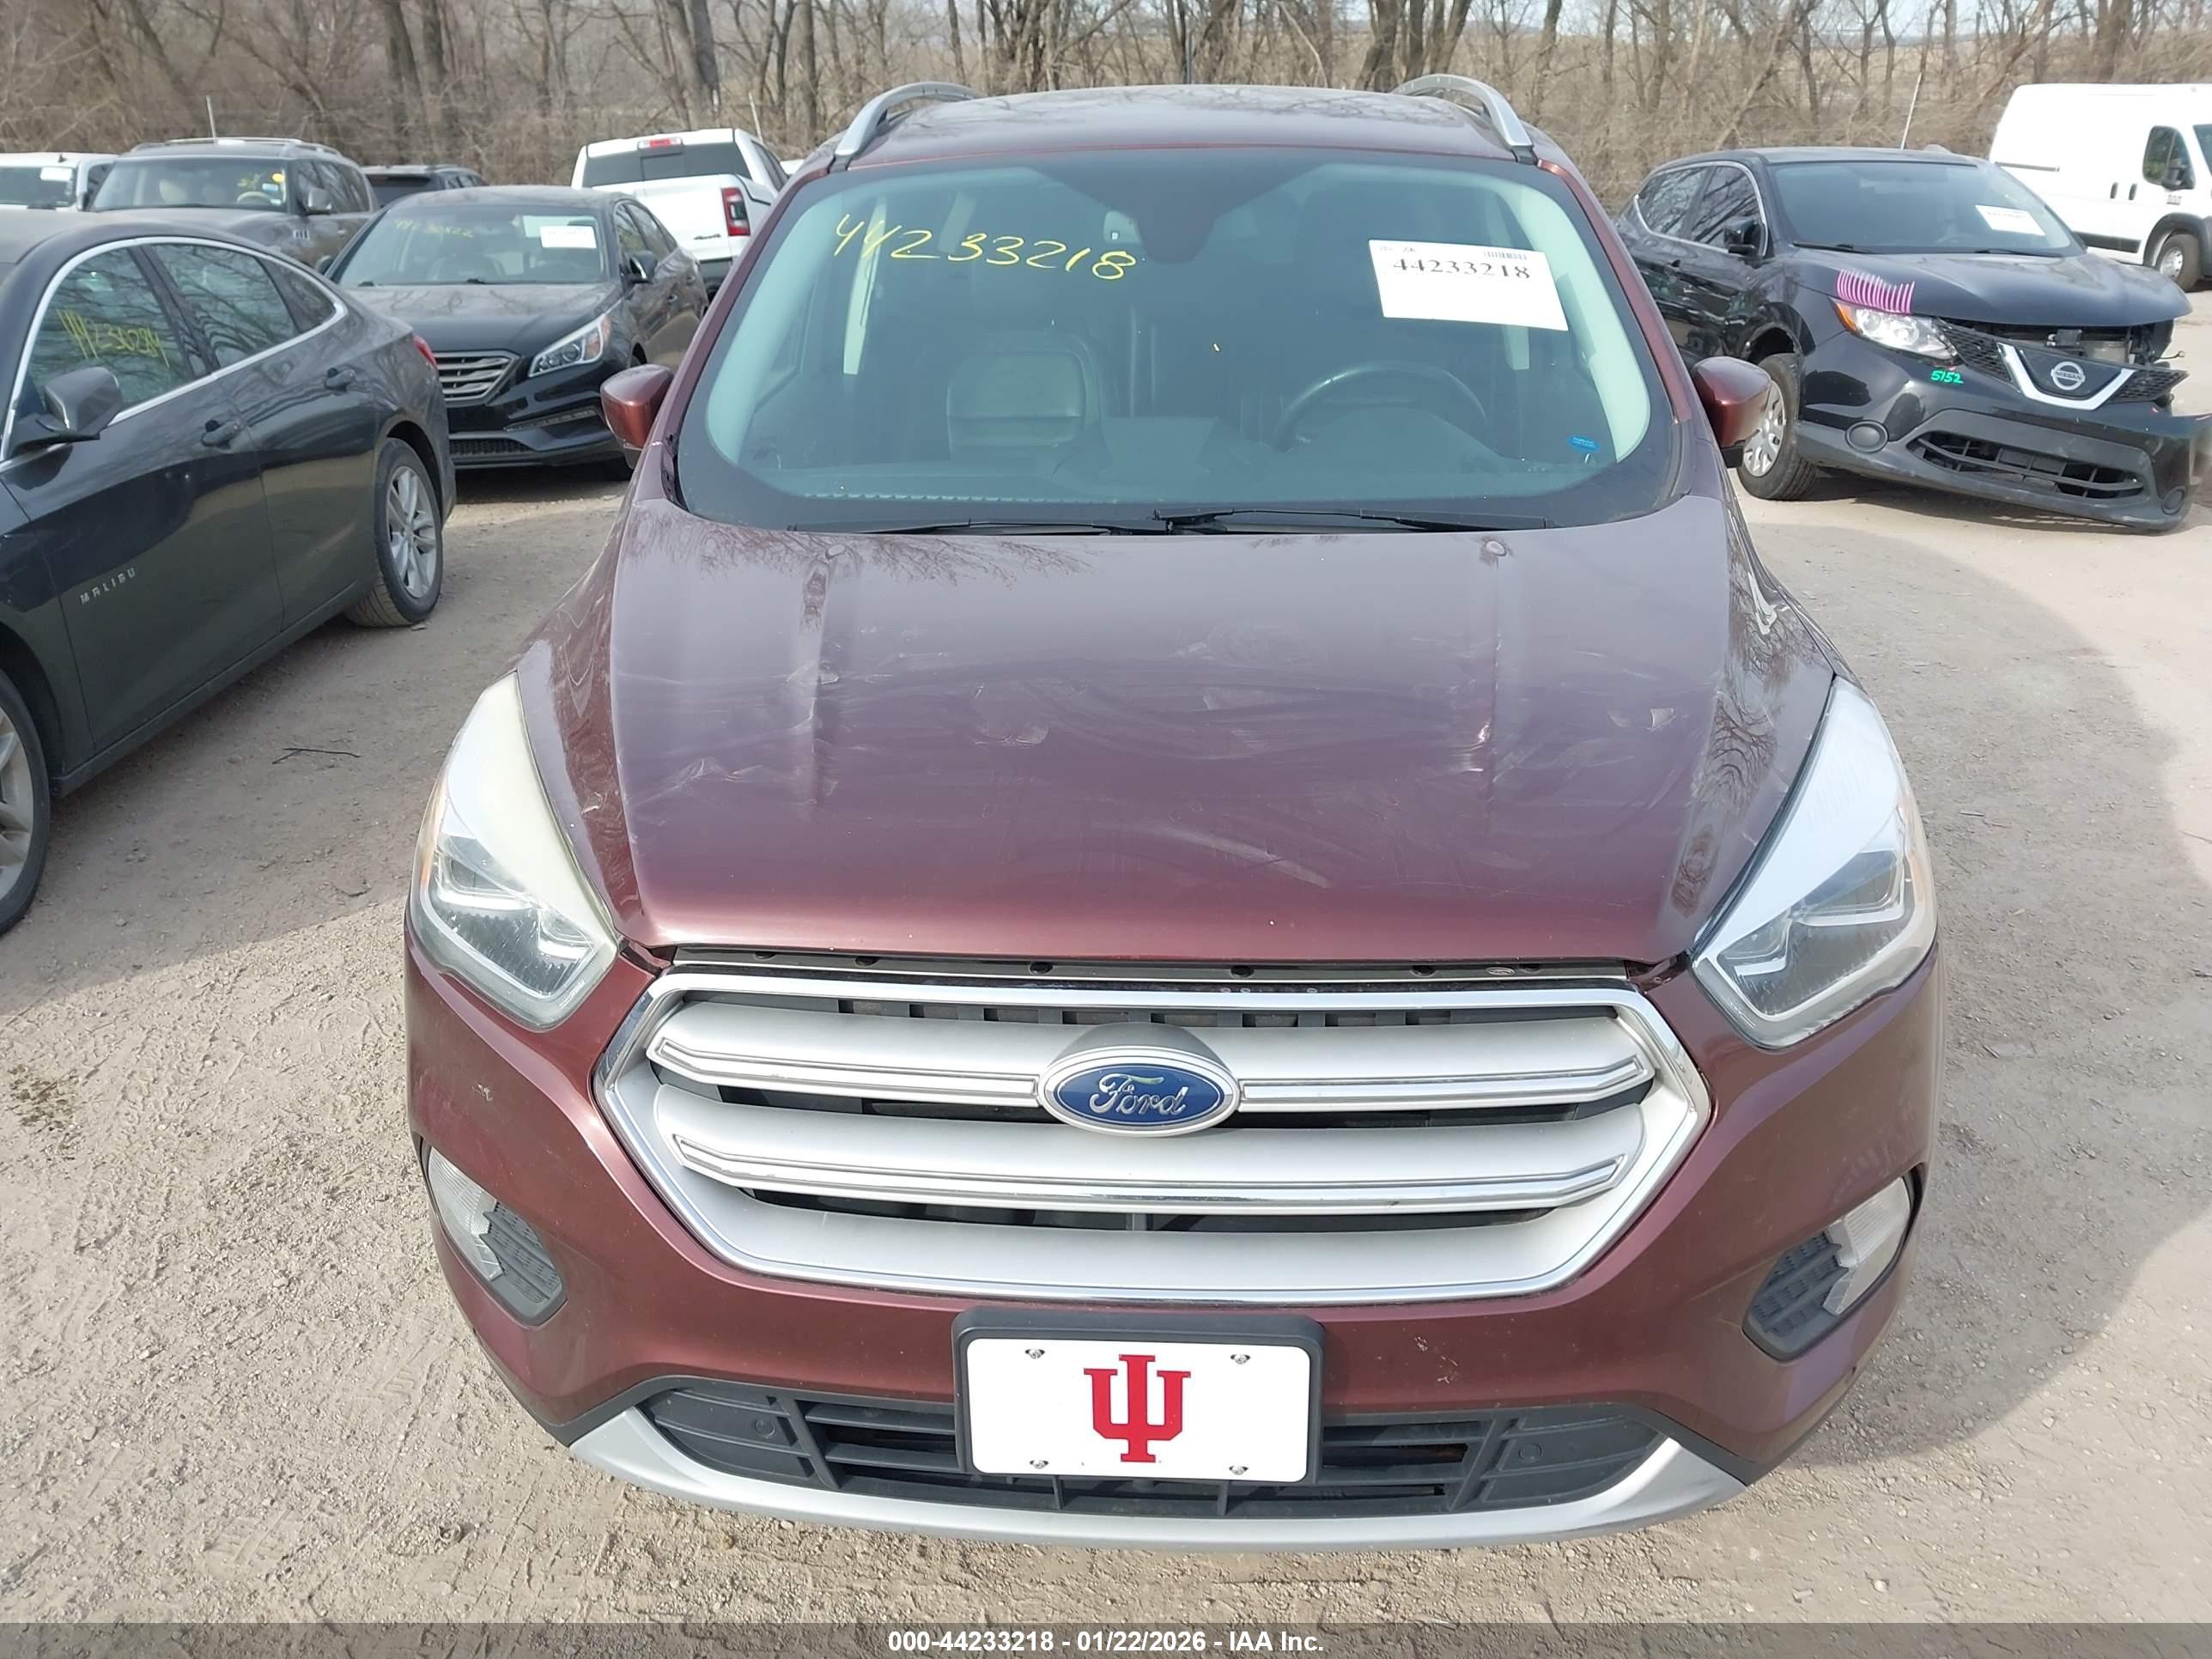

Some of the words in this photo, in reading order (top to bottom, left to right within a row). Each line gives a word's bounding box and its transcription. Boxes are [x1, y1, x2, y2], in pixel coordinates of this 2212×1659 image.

[834, 214, 1136, 279] 44233218
[1393, 258, 1531, 279] 44233218
[80, 568, 136, 605] MALIBU
[1089, 1073, 1189, 1115] Ford
